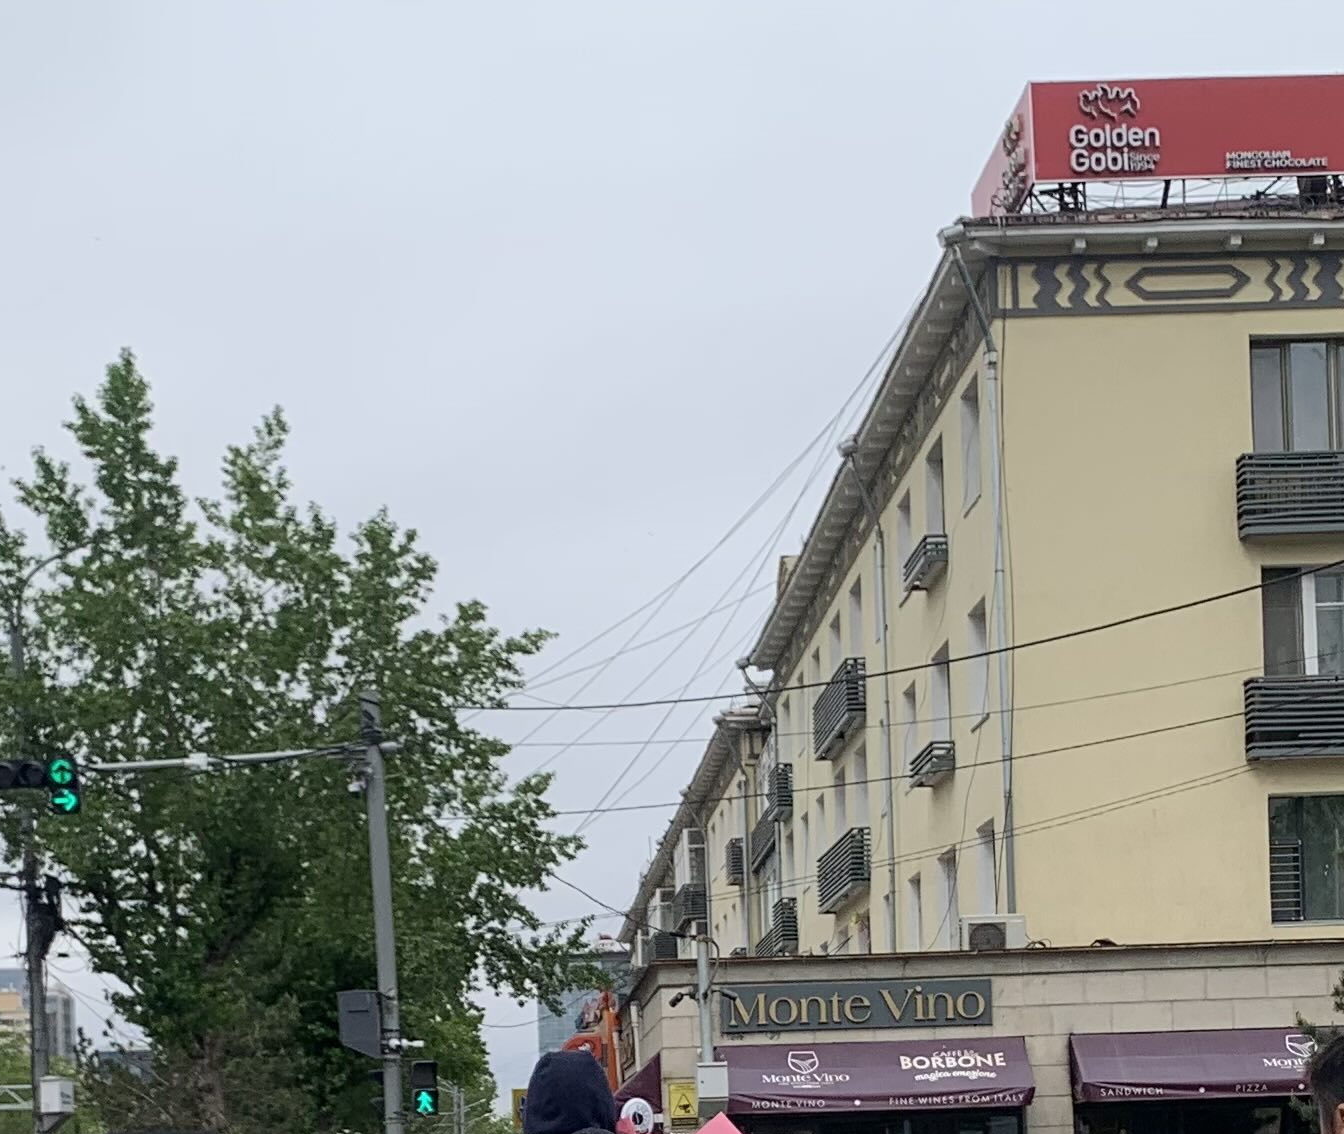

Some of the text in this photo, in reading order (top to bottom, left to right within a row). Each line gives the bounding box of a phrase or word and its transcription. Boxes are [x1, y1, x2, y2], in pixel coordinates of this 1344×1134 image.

[1069, 123, 1160, 147] Golden
[1070, 147, 1130, 172] Gobi
[1226, 150, 1291, 160] MONGOLIAN
[1226, 157, 1328, 169] FINEST CHOCOLATE
[729, 985, 986, 1027] Monte Vino
[899, 1052, 1006, 1070] BORBONE
[761, 1074, 811, 1084] Monte
[813, 1072, 850, 1083] Vino
[1100, 1083, 1269, 1097] SANDWICH PIZZA
[751, 1099, 826, 1109] MONTE VINO
[889, 1093, 1025, 1105] FINE WINES FROM ITALY
